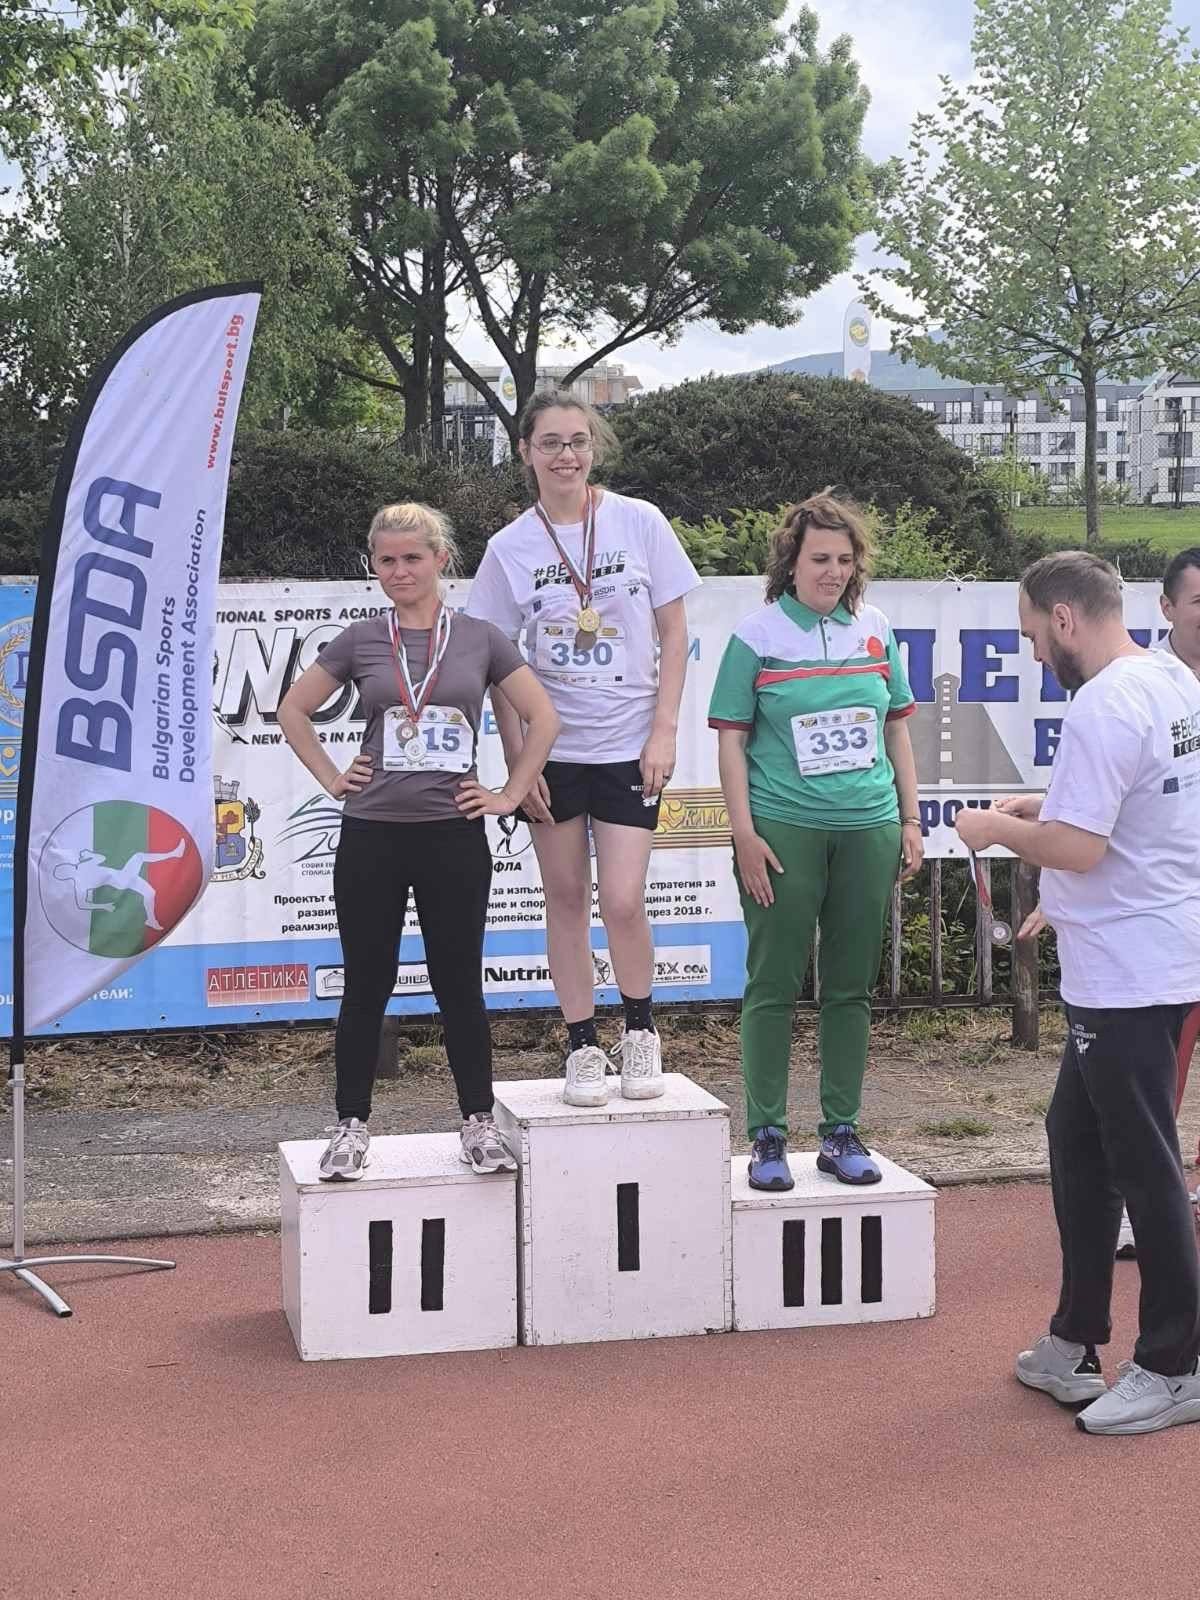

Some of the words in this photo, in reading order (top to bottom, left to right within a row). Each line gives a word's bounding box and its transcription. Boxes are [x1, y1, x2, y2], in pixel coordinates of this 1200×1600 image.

[207, 313, 245, 469] www.bulsport.bg
[181, 508, 206, 635] Association
[56, 476, 162, 772] BSDA
[274, 608, 331, 621] SPORTS
[156, 596, 176, 667] Sports
[551, 642, 613, 666] 350
[179, 640, 198, 783] Development
[152, 672, 174, 780] Bulgarian
[252, 734, 282, 745] NEW
[330, 732, 343, 743] IN
[422, 727, 461, 752] 15
[810, 727, 868, 755] 333
[494, 861, 521, 872] ФЛА
[274, 895, 326, 906] Проектът
[650, 880, 702, 891] стратегия
[705, 880, 716, 888] за
[675, 895, 681, 903] и
[684, 894, 697, 902] се
[647, 909, 671, 918] през
[674, 905, 702, 916] 2018
[209, 969, 308, 991] АТЛЕТИКА
